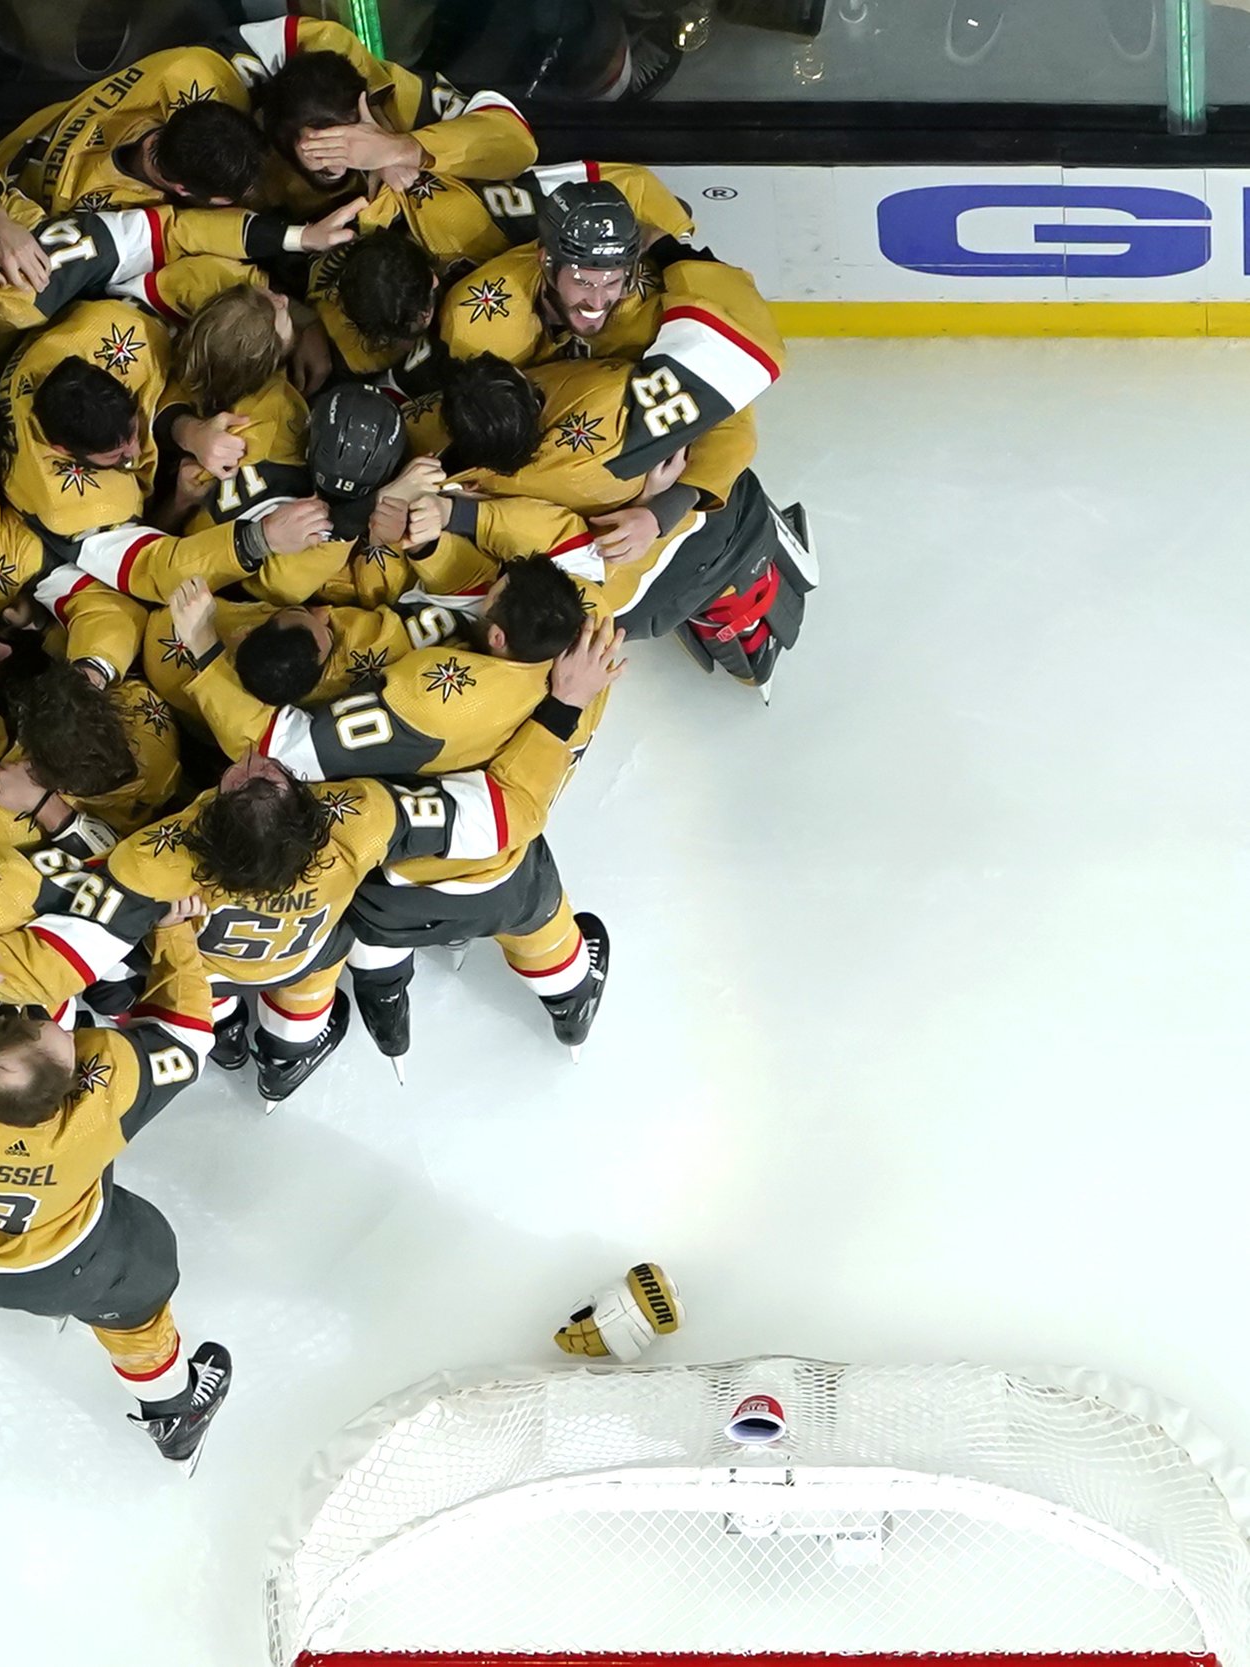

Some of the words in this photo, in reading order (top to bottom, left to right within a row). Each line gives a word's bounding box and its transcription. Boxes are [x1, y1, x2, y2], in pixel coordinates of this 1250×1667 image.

[592, 246, 625, 255] CCM
[877, 184, 1250, 279] G
[632, 365, 700, 437] 33
[335, 478, 355, 492] 19
[196, 903, 331, 962] 61
[149, 1046, 195, 1087] 8
